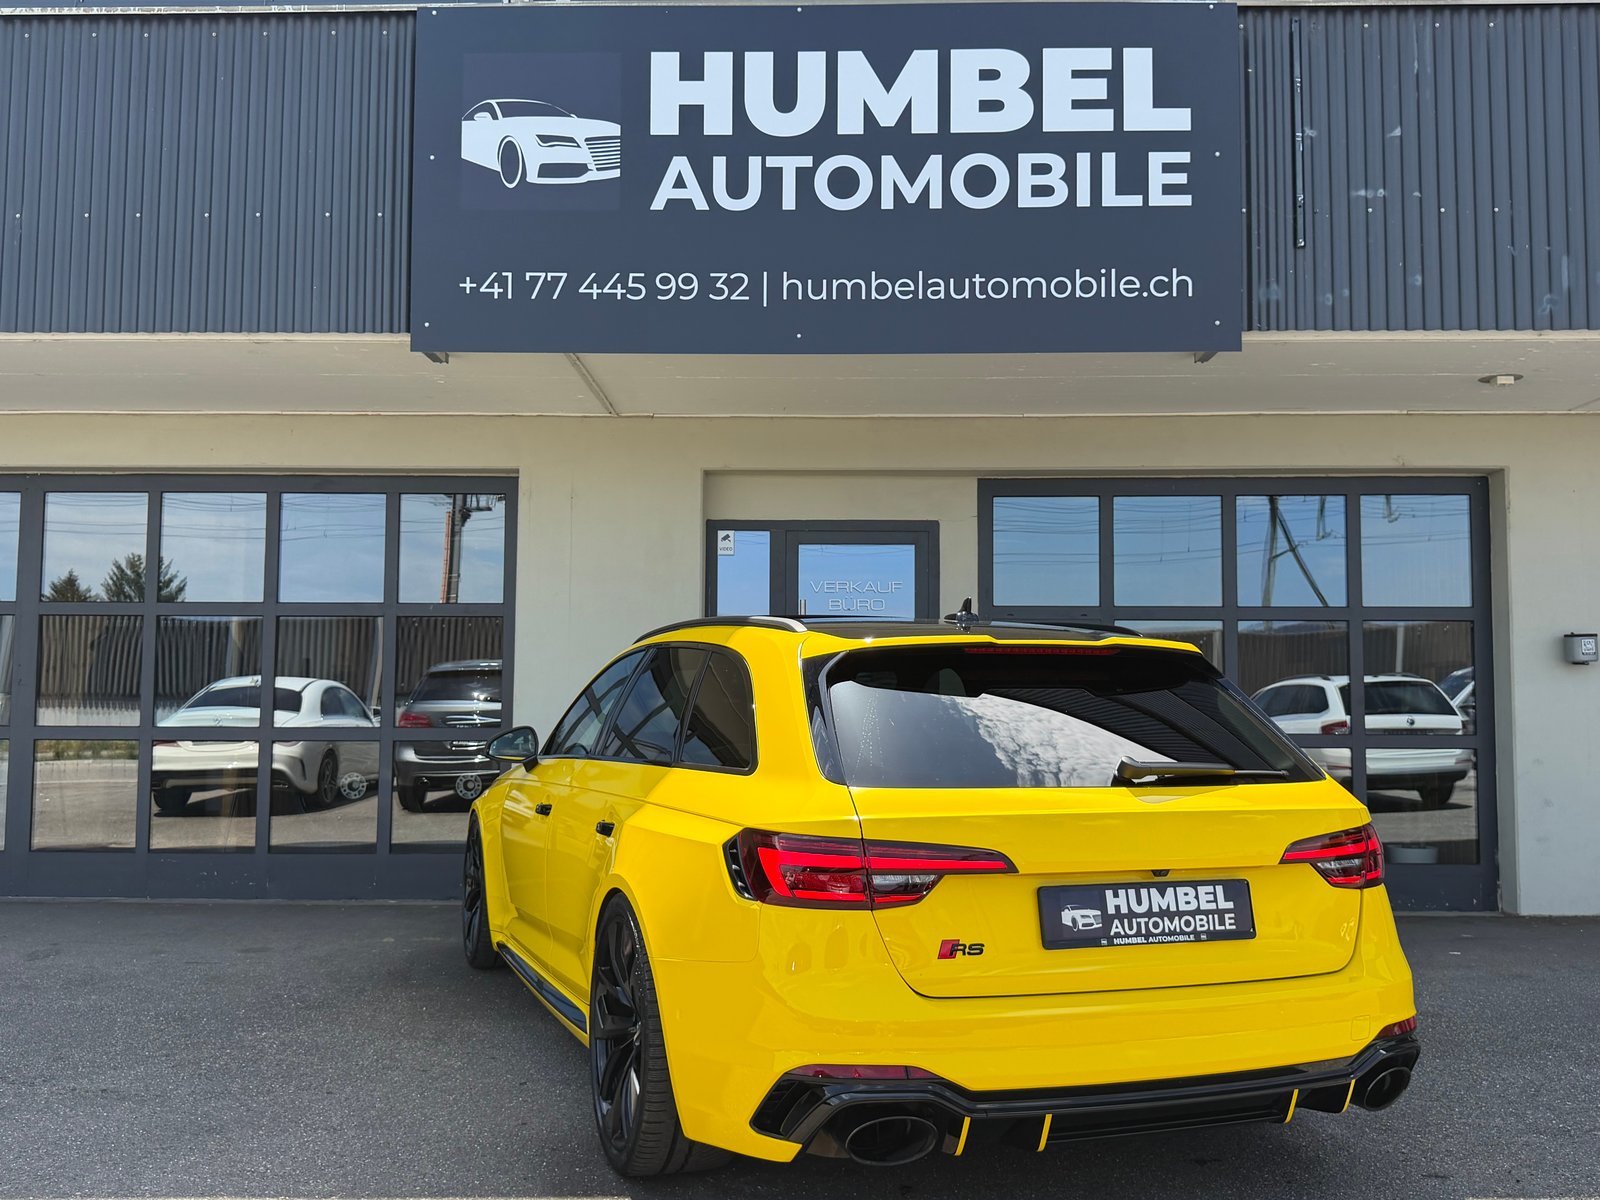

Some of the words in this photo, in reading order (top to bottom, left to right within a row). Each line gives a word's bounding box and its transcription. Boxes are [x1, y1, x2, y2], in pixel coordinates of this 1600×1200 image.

[650, 47, 1192, 137] HUMBEL
[650, 151, 1193, 212] AUTOMOBILE
[459, 272, 512, 300] +41
[525, 272, 567, 300] 77
[579, 272, 647, 301] 445
[656, 272, 699, 301] 99
[709, 272, 750, 301] 32
[782, 267, 1193, 301] humbelautomobile.ch
[810, 580, 903, 594] VERKAUF
[828, 597, 886, 611] BÜRO
[1104, 885, 1234, 915] HUMBEL
[1110, 913, 1236, 936] AUTOMOBILE
[1113, 936, 1147, 945] HUMBEL
[1148, 934, 1195, 943] AUTOMOBILE
[947, 942, 985, 957] RS
